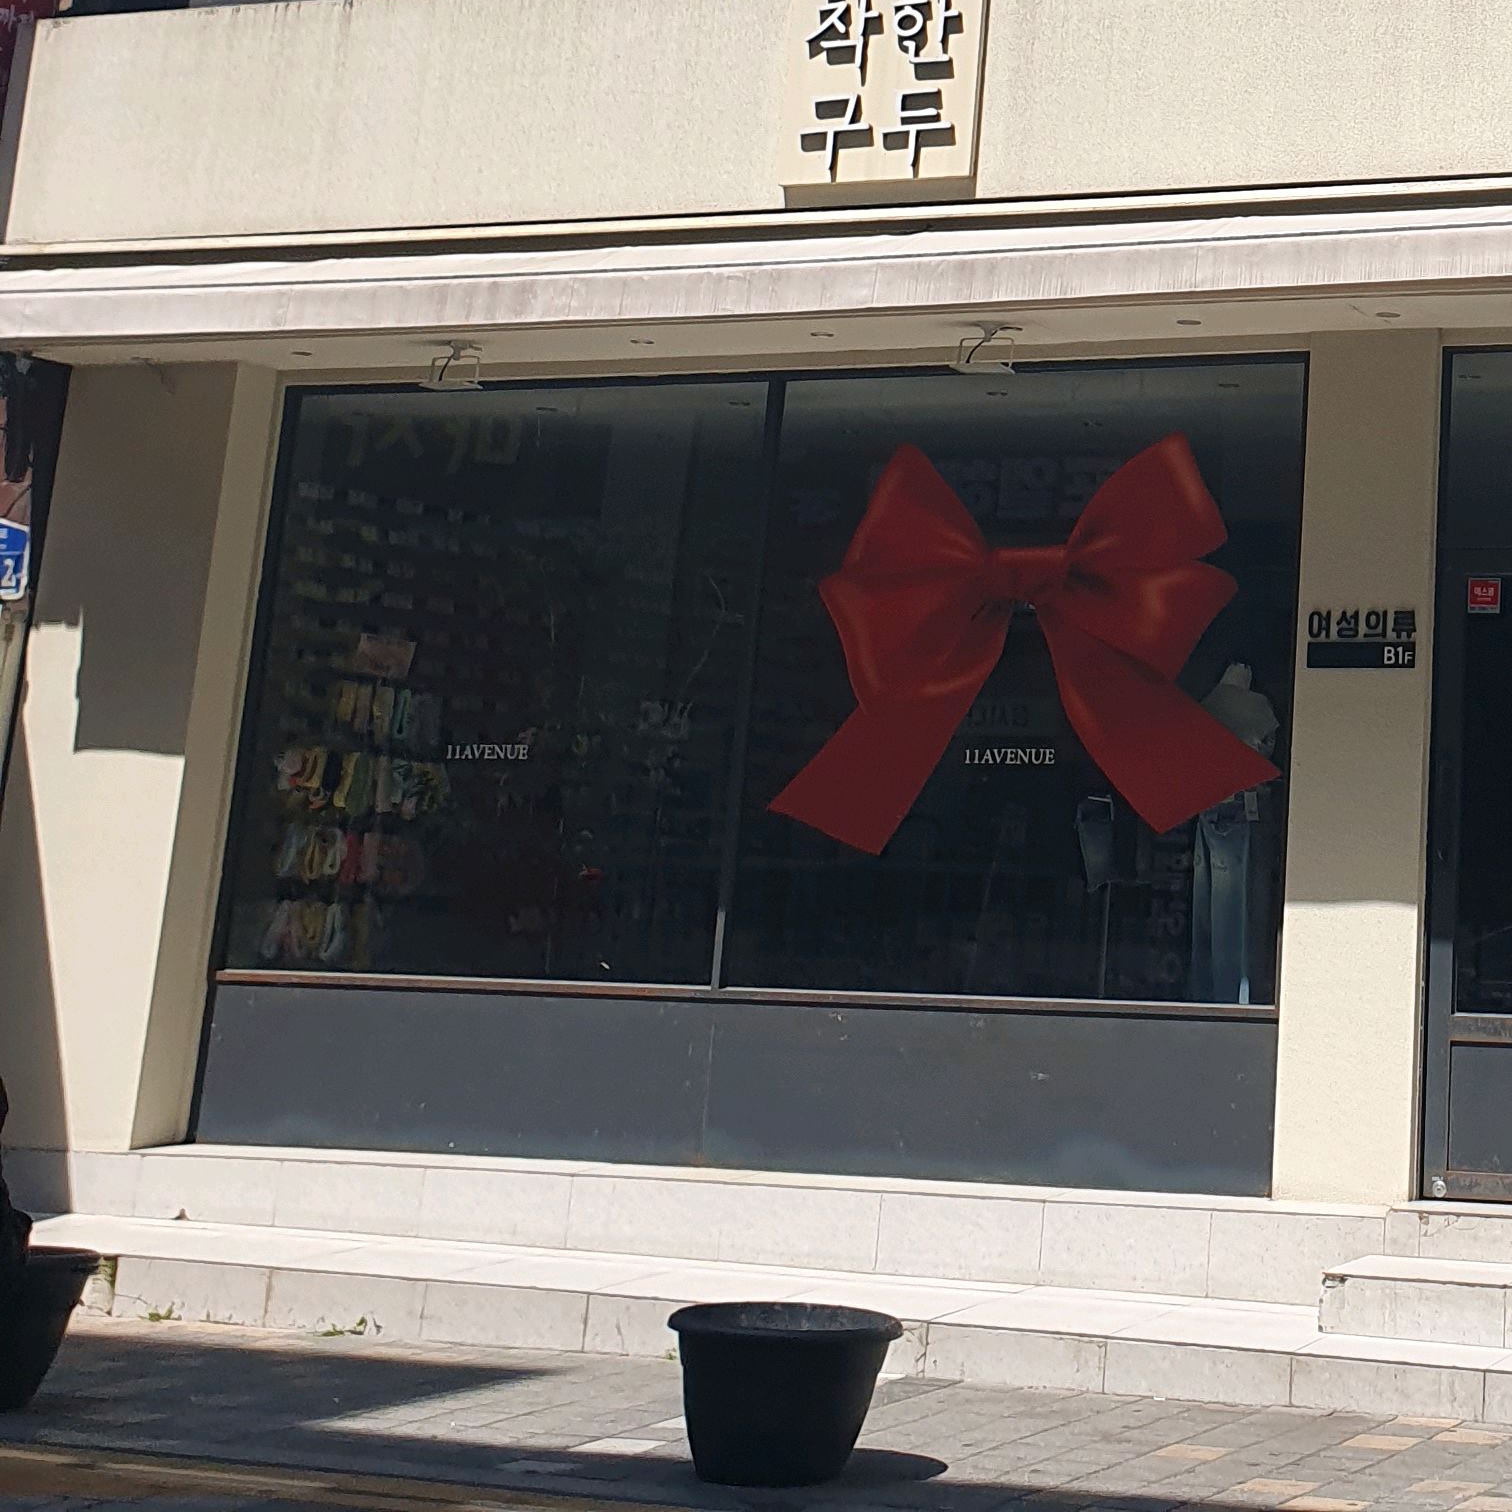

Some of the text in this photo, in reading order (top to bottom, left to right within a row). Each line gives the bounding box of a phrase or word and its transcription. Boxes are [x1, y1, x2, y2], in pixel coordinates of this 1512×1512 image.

[798, 88, 954, 172] 구두
[1307, 608, 1418, 639] 여성의류
[1383, 646, 1414, 666] B1F
[446, 743, 529, 761] 11AVENUE
[963, 747, 1055, 765] 11AVENUE
